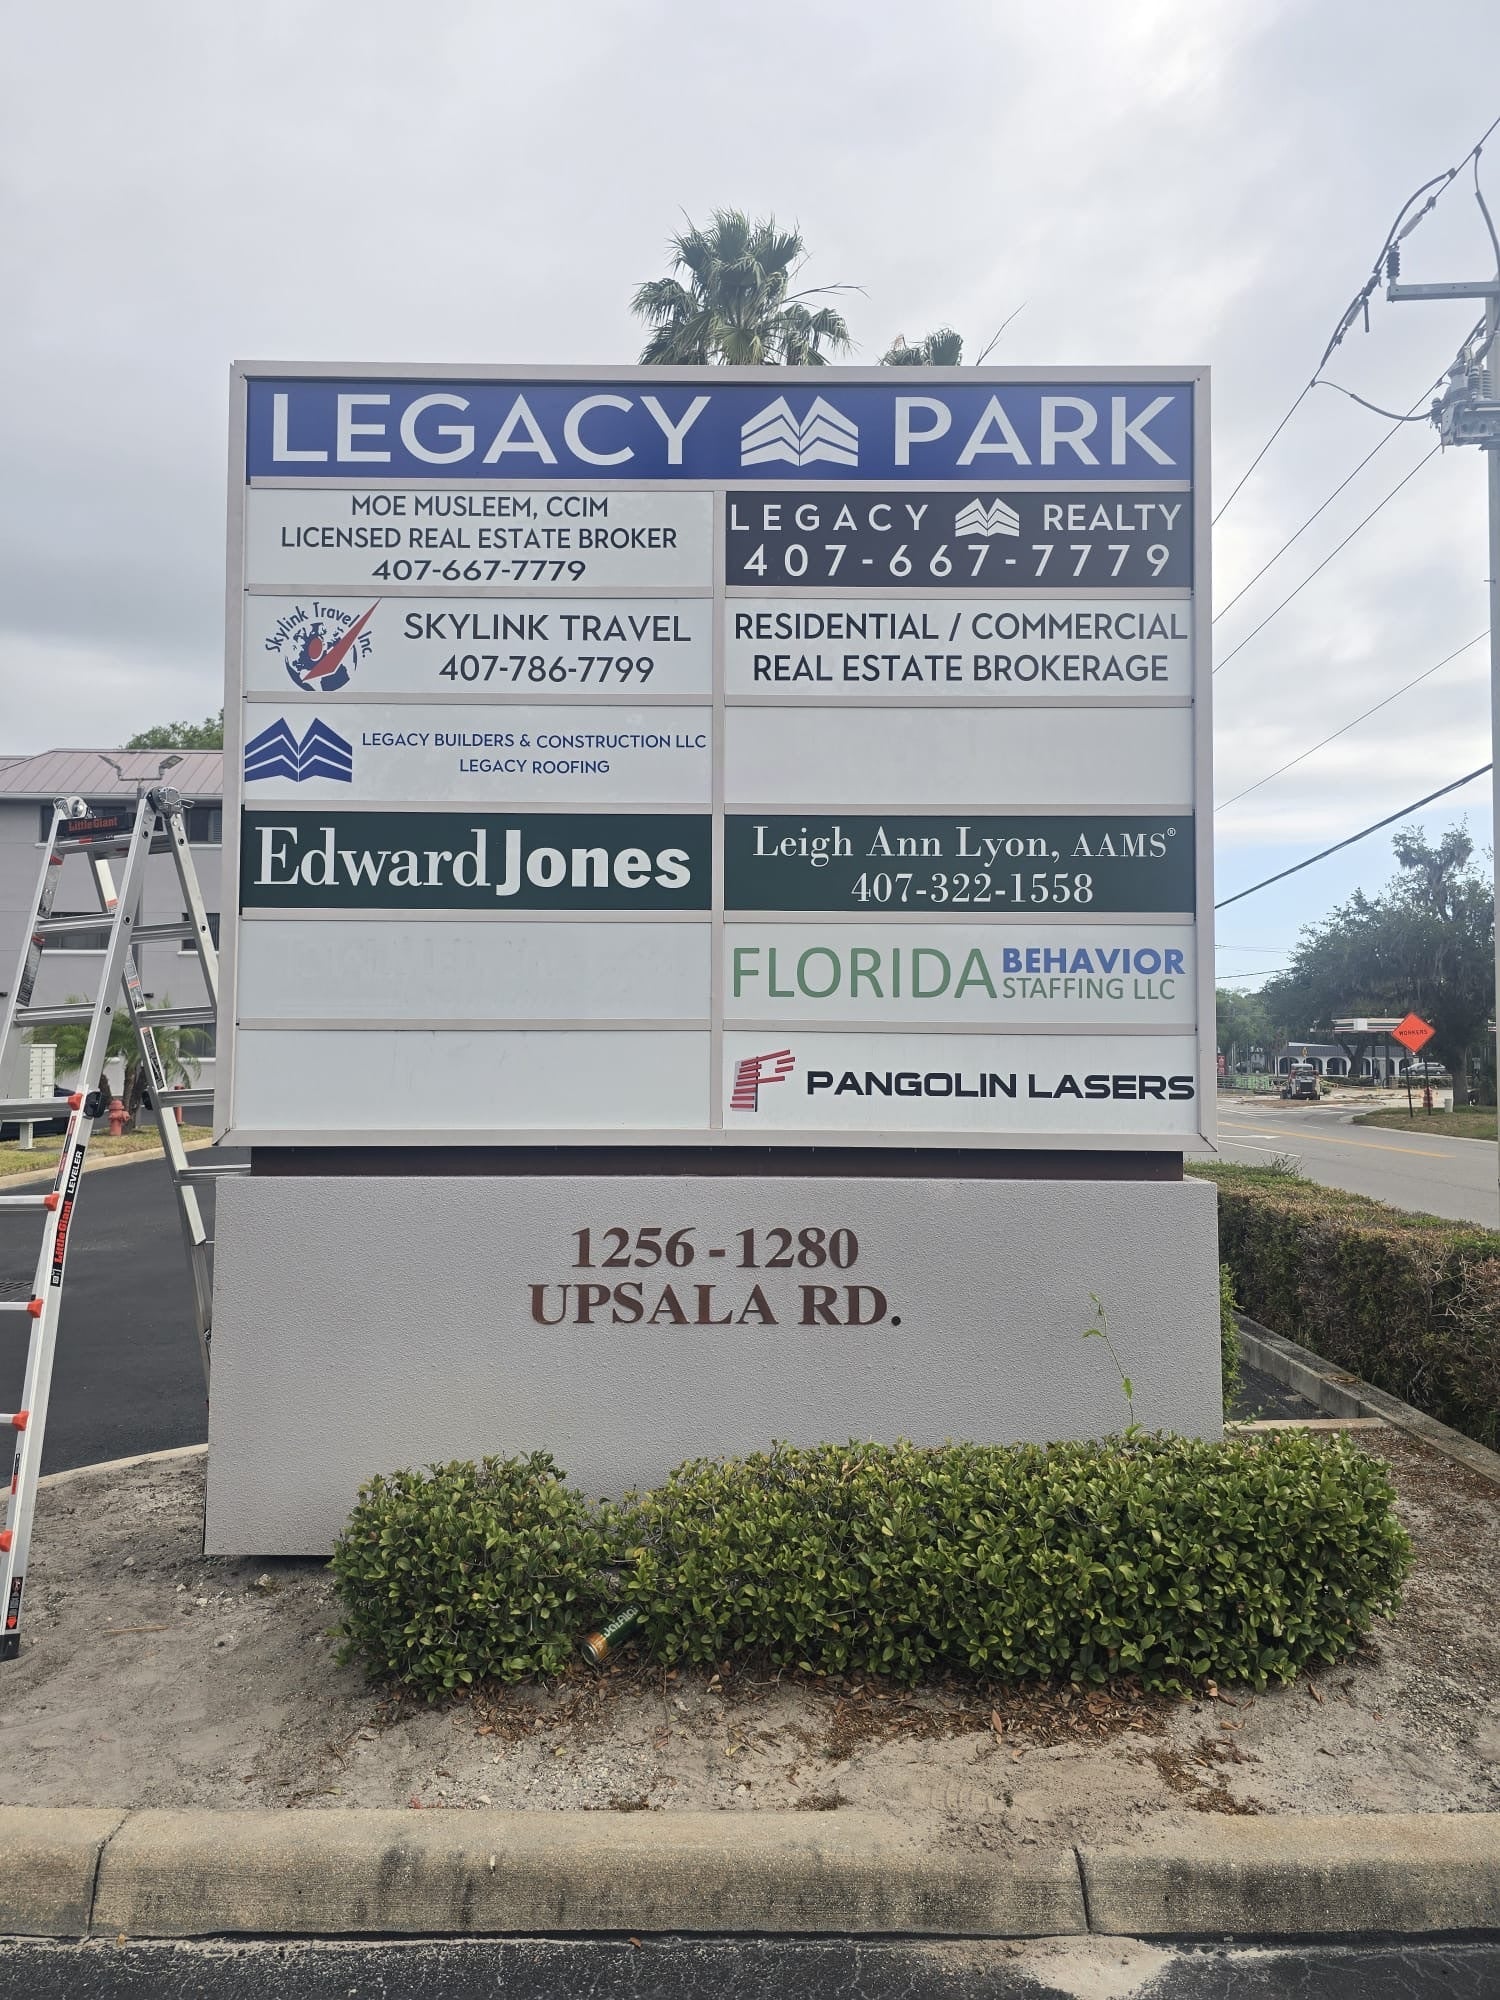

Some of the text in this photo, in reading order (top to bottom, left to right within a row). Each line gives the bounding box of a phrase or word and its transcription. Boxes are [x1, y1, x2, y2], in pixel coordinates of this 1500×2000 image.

[273, 394, 1176, 465] LEGACY PARK
[352, 495, 607, 520] MOE MUSLEEM, CCIM
[732, 504, 1181, 531] LEGACY REALTY
[282, 527, 676, 548] LICENSED REAL ESTATE BROKER
[372, 560, 585, 581] 407-667-7779
[744, 544, 1169, 576] 407-667-7779
[266, 602, 372, 658] Skylink Travel Inc.
[404, 613, 691, 641] SKYLINK TRAVEL
[736, 613, 1187, 641] RESIDENTIAL / COMMERCIAL
[439, 655, 654, 682] 407-786-7799
[754, 655, 1168, 681] REAL ESTATE BROKERAGE
[363, 733, 706, 748] LEGACY BUILDERS & CONSTRUCTION LLC
[460, 759, 609, 774] LEGACY ROOFING
[753, 826, 853, 867] Leigh
[866, 826, 943, 856] Ann
[956, 827, 1059, 867] Lyon,
[254, 827, 690, 895] Edward Jones
[852, 873, 1092, 903] 407-322-1558
[734, 947, 1185, 998] FLORIDA BEHAVIOR
[1003, 978, 1175, 999] STAFFING LLC
[808, 1071, 1194, 1100] PANGOLIN LASERS
[67, 1151, 82, 1194] LEVELER
[528, 1282, 901, 1326] UPSALA RD.
